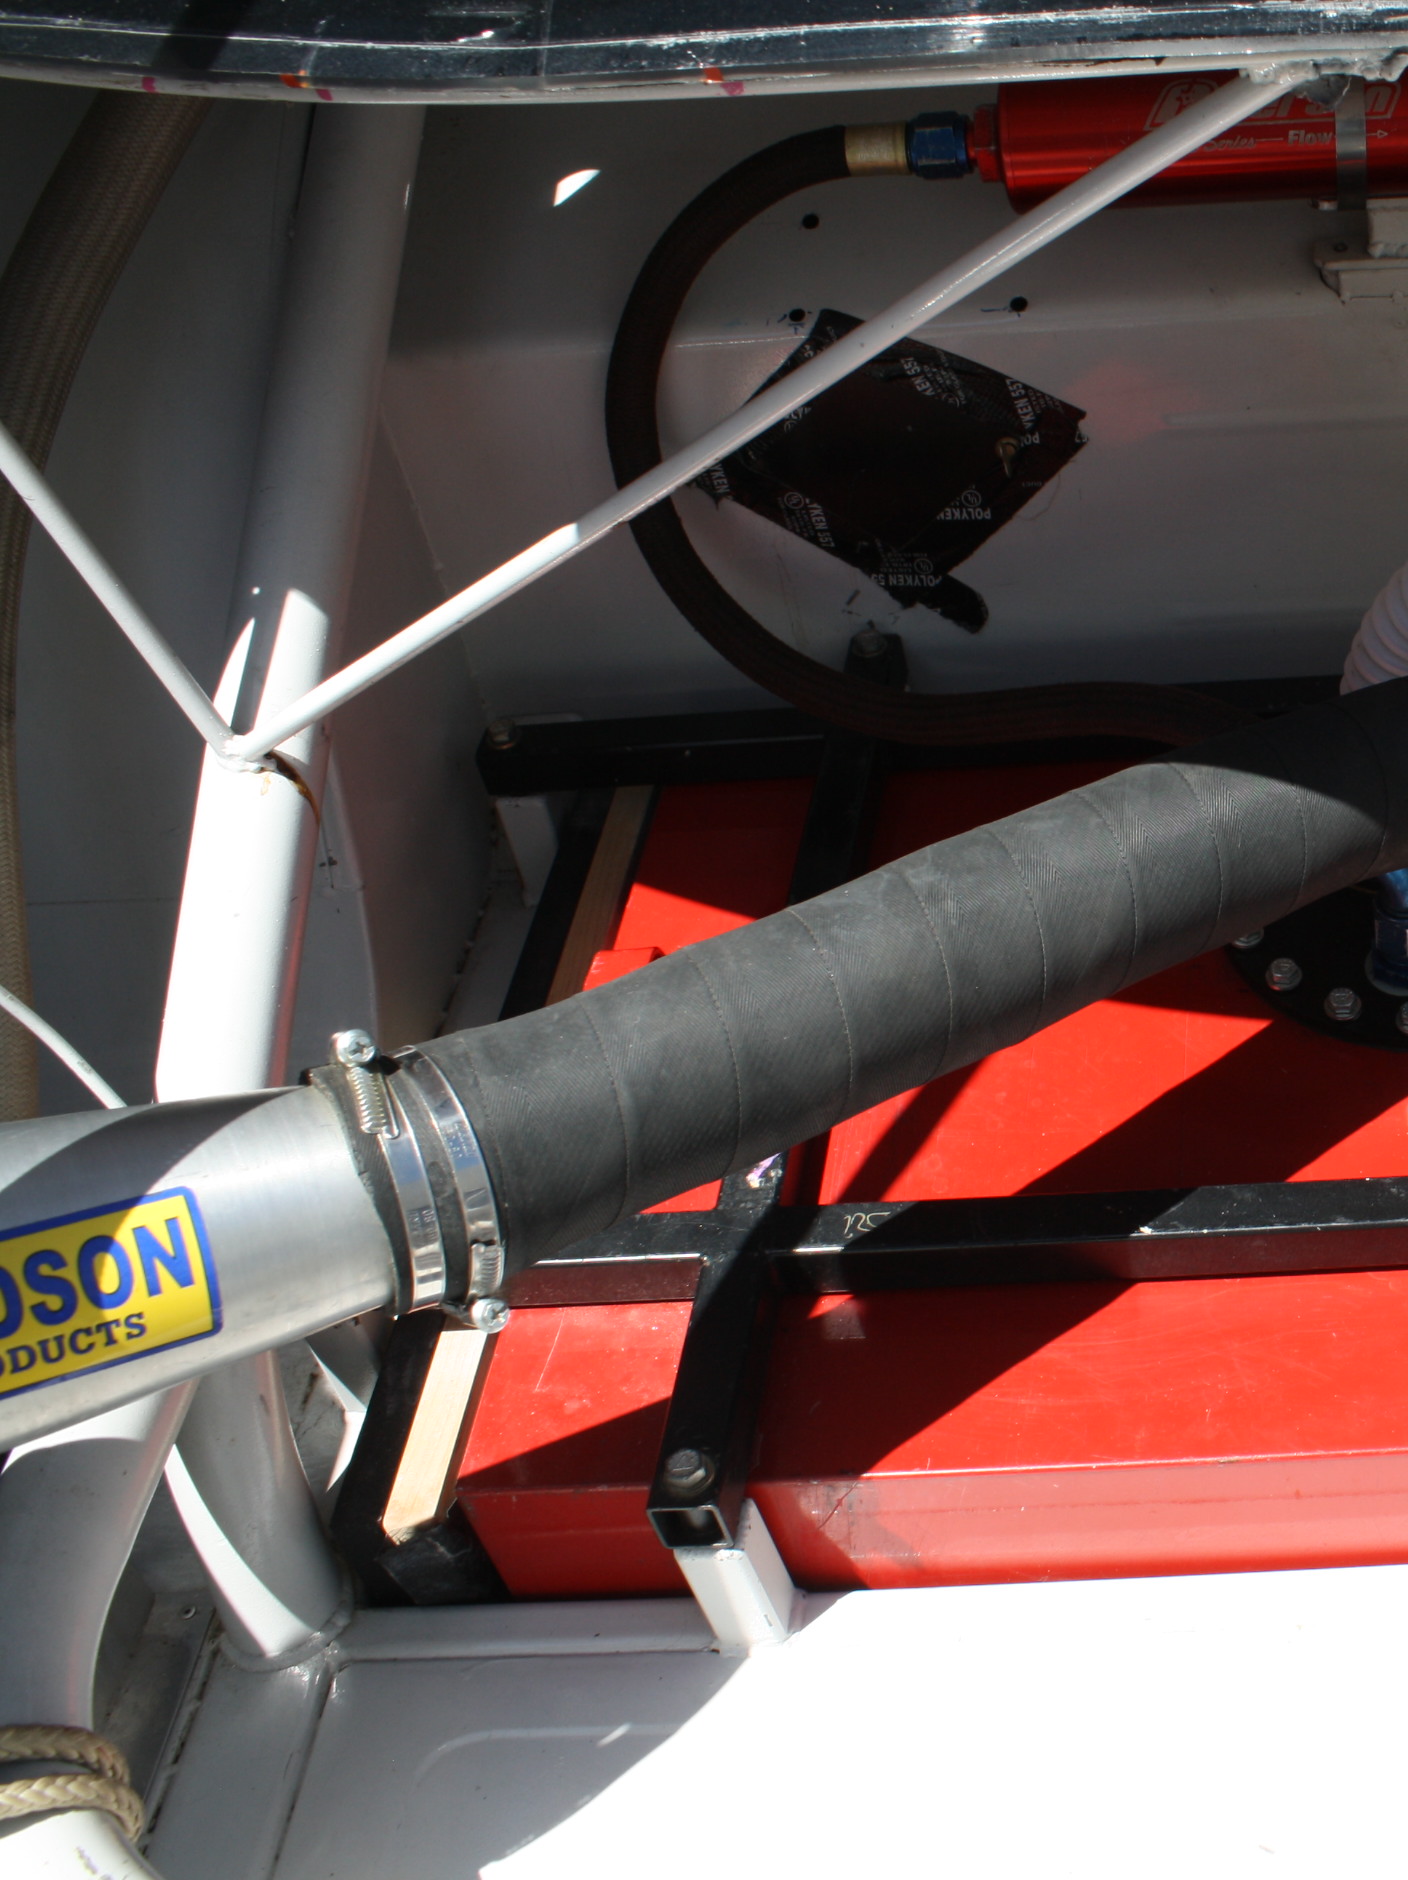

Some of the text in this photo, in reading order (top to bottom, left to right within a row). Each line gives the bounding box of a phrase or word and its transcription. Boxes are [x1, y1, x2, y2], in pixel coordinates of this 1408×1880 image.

[1287, 130, 1333, 147] Flow
[1005, 378, 1026, 398] 557
[936, 507, 993, 521] POLYKEN
[0, 1312, 147, 1379] DUCTS
